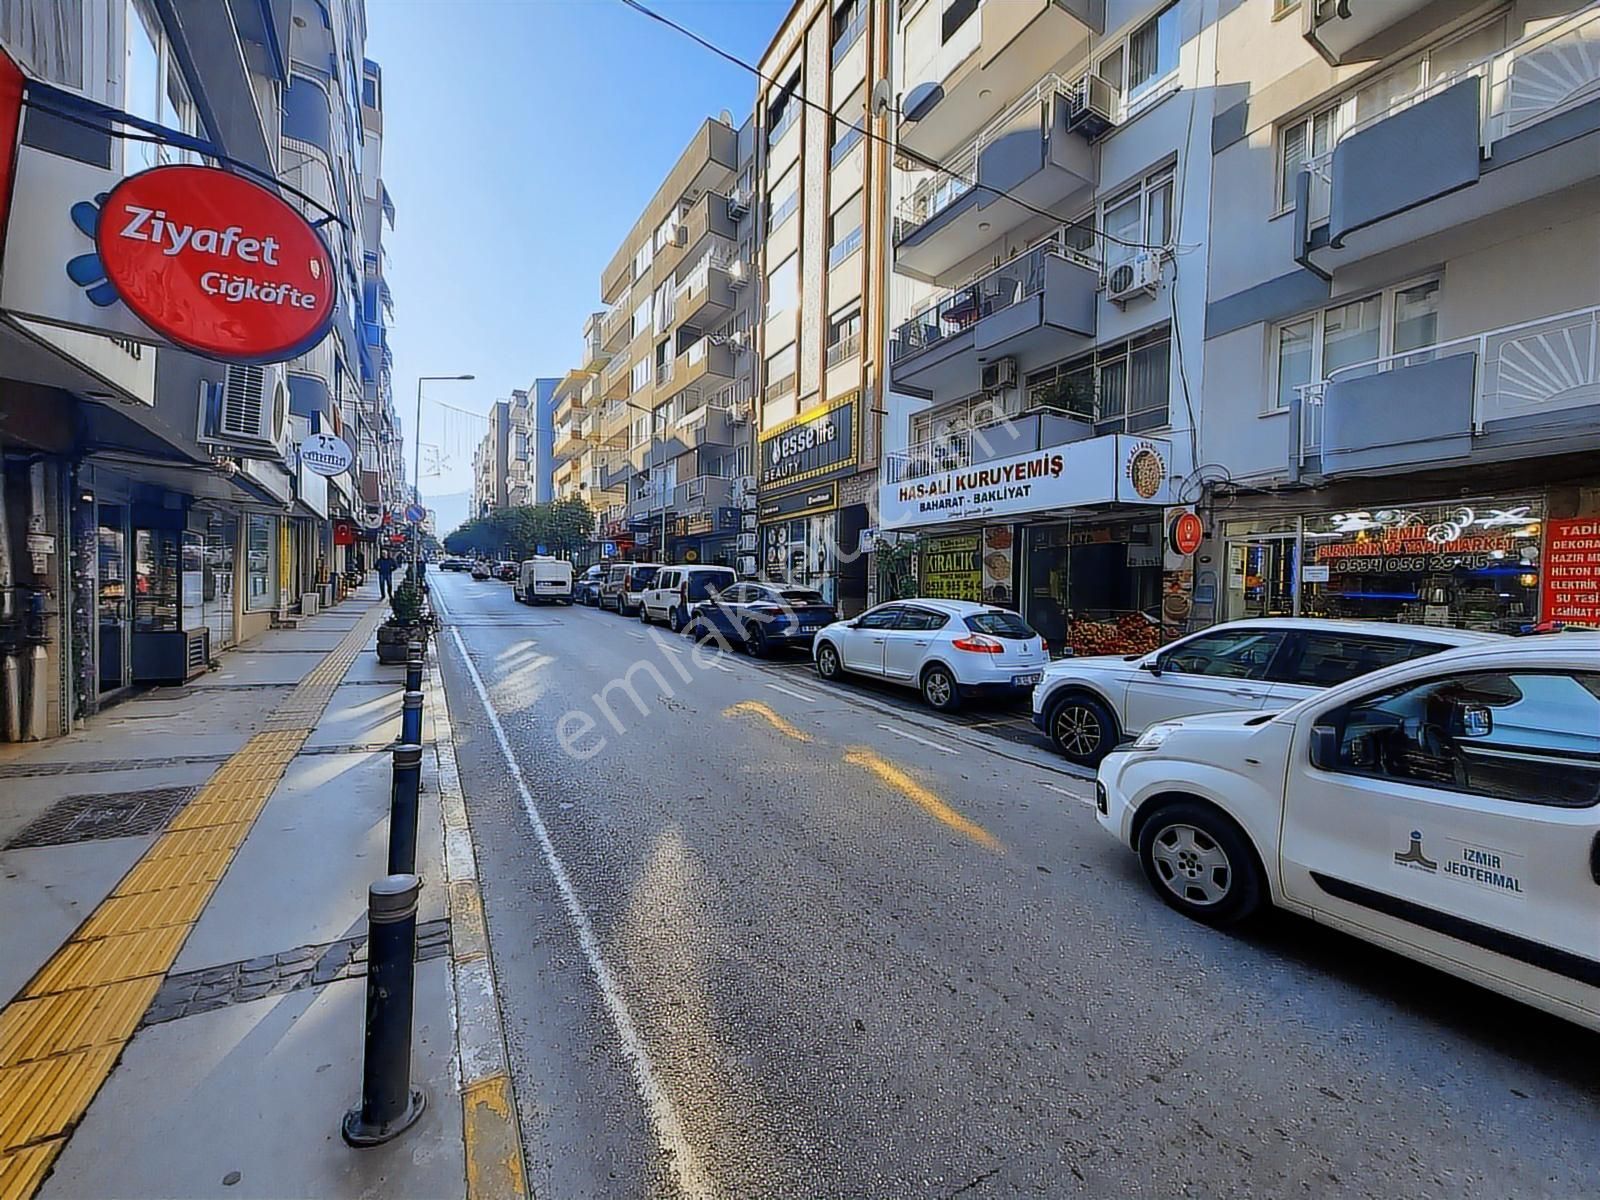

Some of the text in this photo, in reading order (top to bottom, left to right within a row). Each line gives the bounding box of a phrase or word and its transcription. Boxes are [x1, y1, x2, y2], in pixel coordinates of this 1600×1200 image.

[120, 205, 280, 266] Ziyafet
[200, 271, 316, 310] Çiğköfte
[763, 462, 800, 482] BEAUTY
[899, 452, 1064, 502] HAS-ALİ KURUYEMİŞ
[920, 496, 965, 513] BAHARAT
[973, 484, 1032, 504] BAKLİYAT
[1560, 522, 1600, 536] TADİ
[1443, 536, 1516, 553] MARKET
[1551, 553, 1584, 563] HAZIR
[1551, 565, 1591, 576] HİLTON
[1551, 578, 1598, 590] ELEKTRİK
[1556, 594, 1571, 603] SU
[1463, 848, 1501, 869] İZMİR
[1443, 860, 1523, 893] JEOTERMAL
